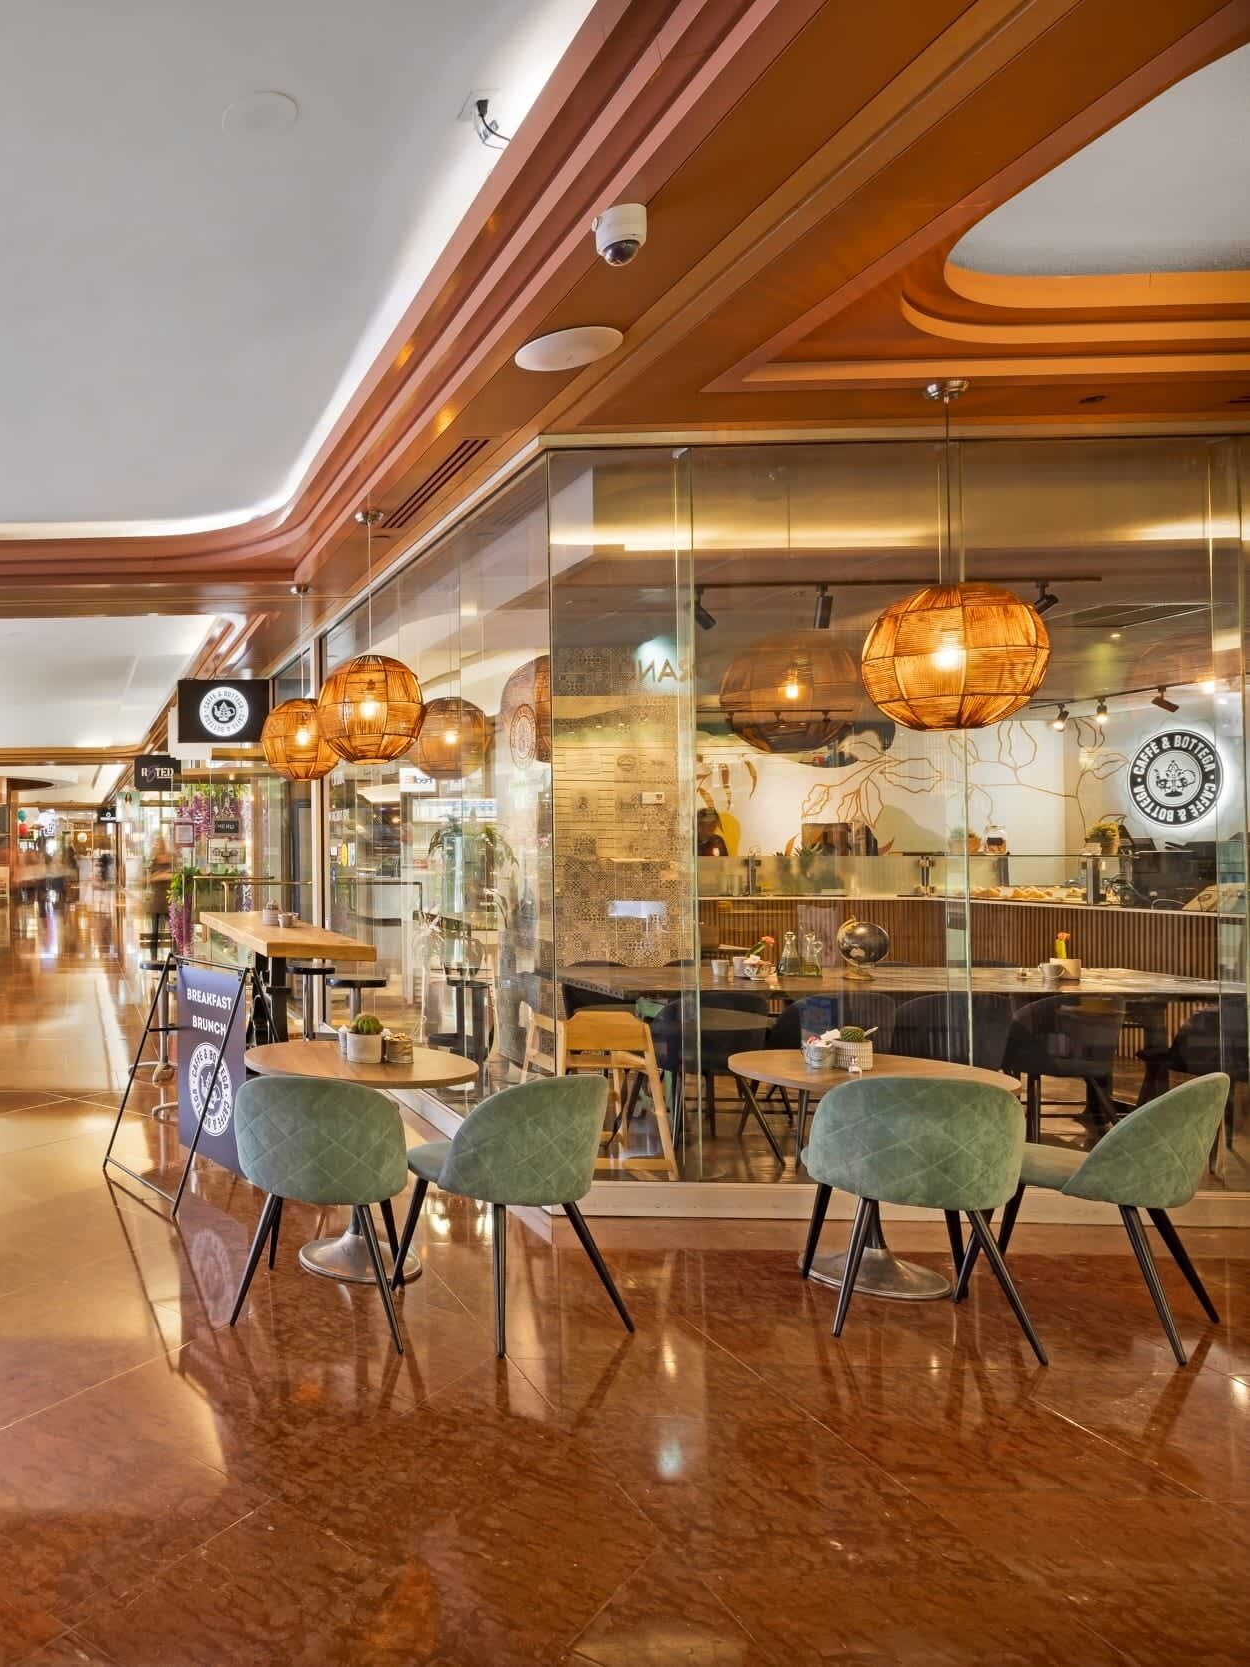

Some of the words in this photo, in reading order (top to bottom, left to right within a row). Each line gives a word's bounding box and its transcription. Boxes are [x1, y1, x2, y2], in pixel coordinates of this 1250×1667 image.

[1161, 736, 1171, 749] &
[1174, 735, 1216, 772] BOTTEGA
[1133, 785, 1174, 822] BOTTEGA
[1177, 809, 1187, 821] &
[186, 988, 232, 1010] BREAKFAST
[192, 1015, 228, 1036] BRUNCH
